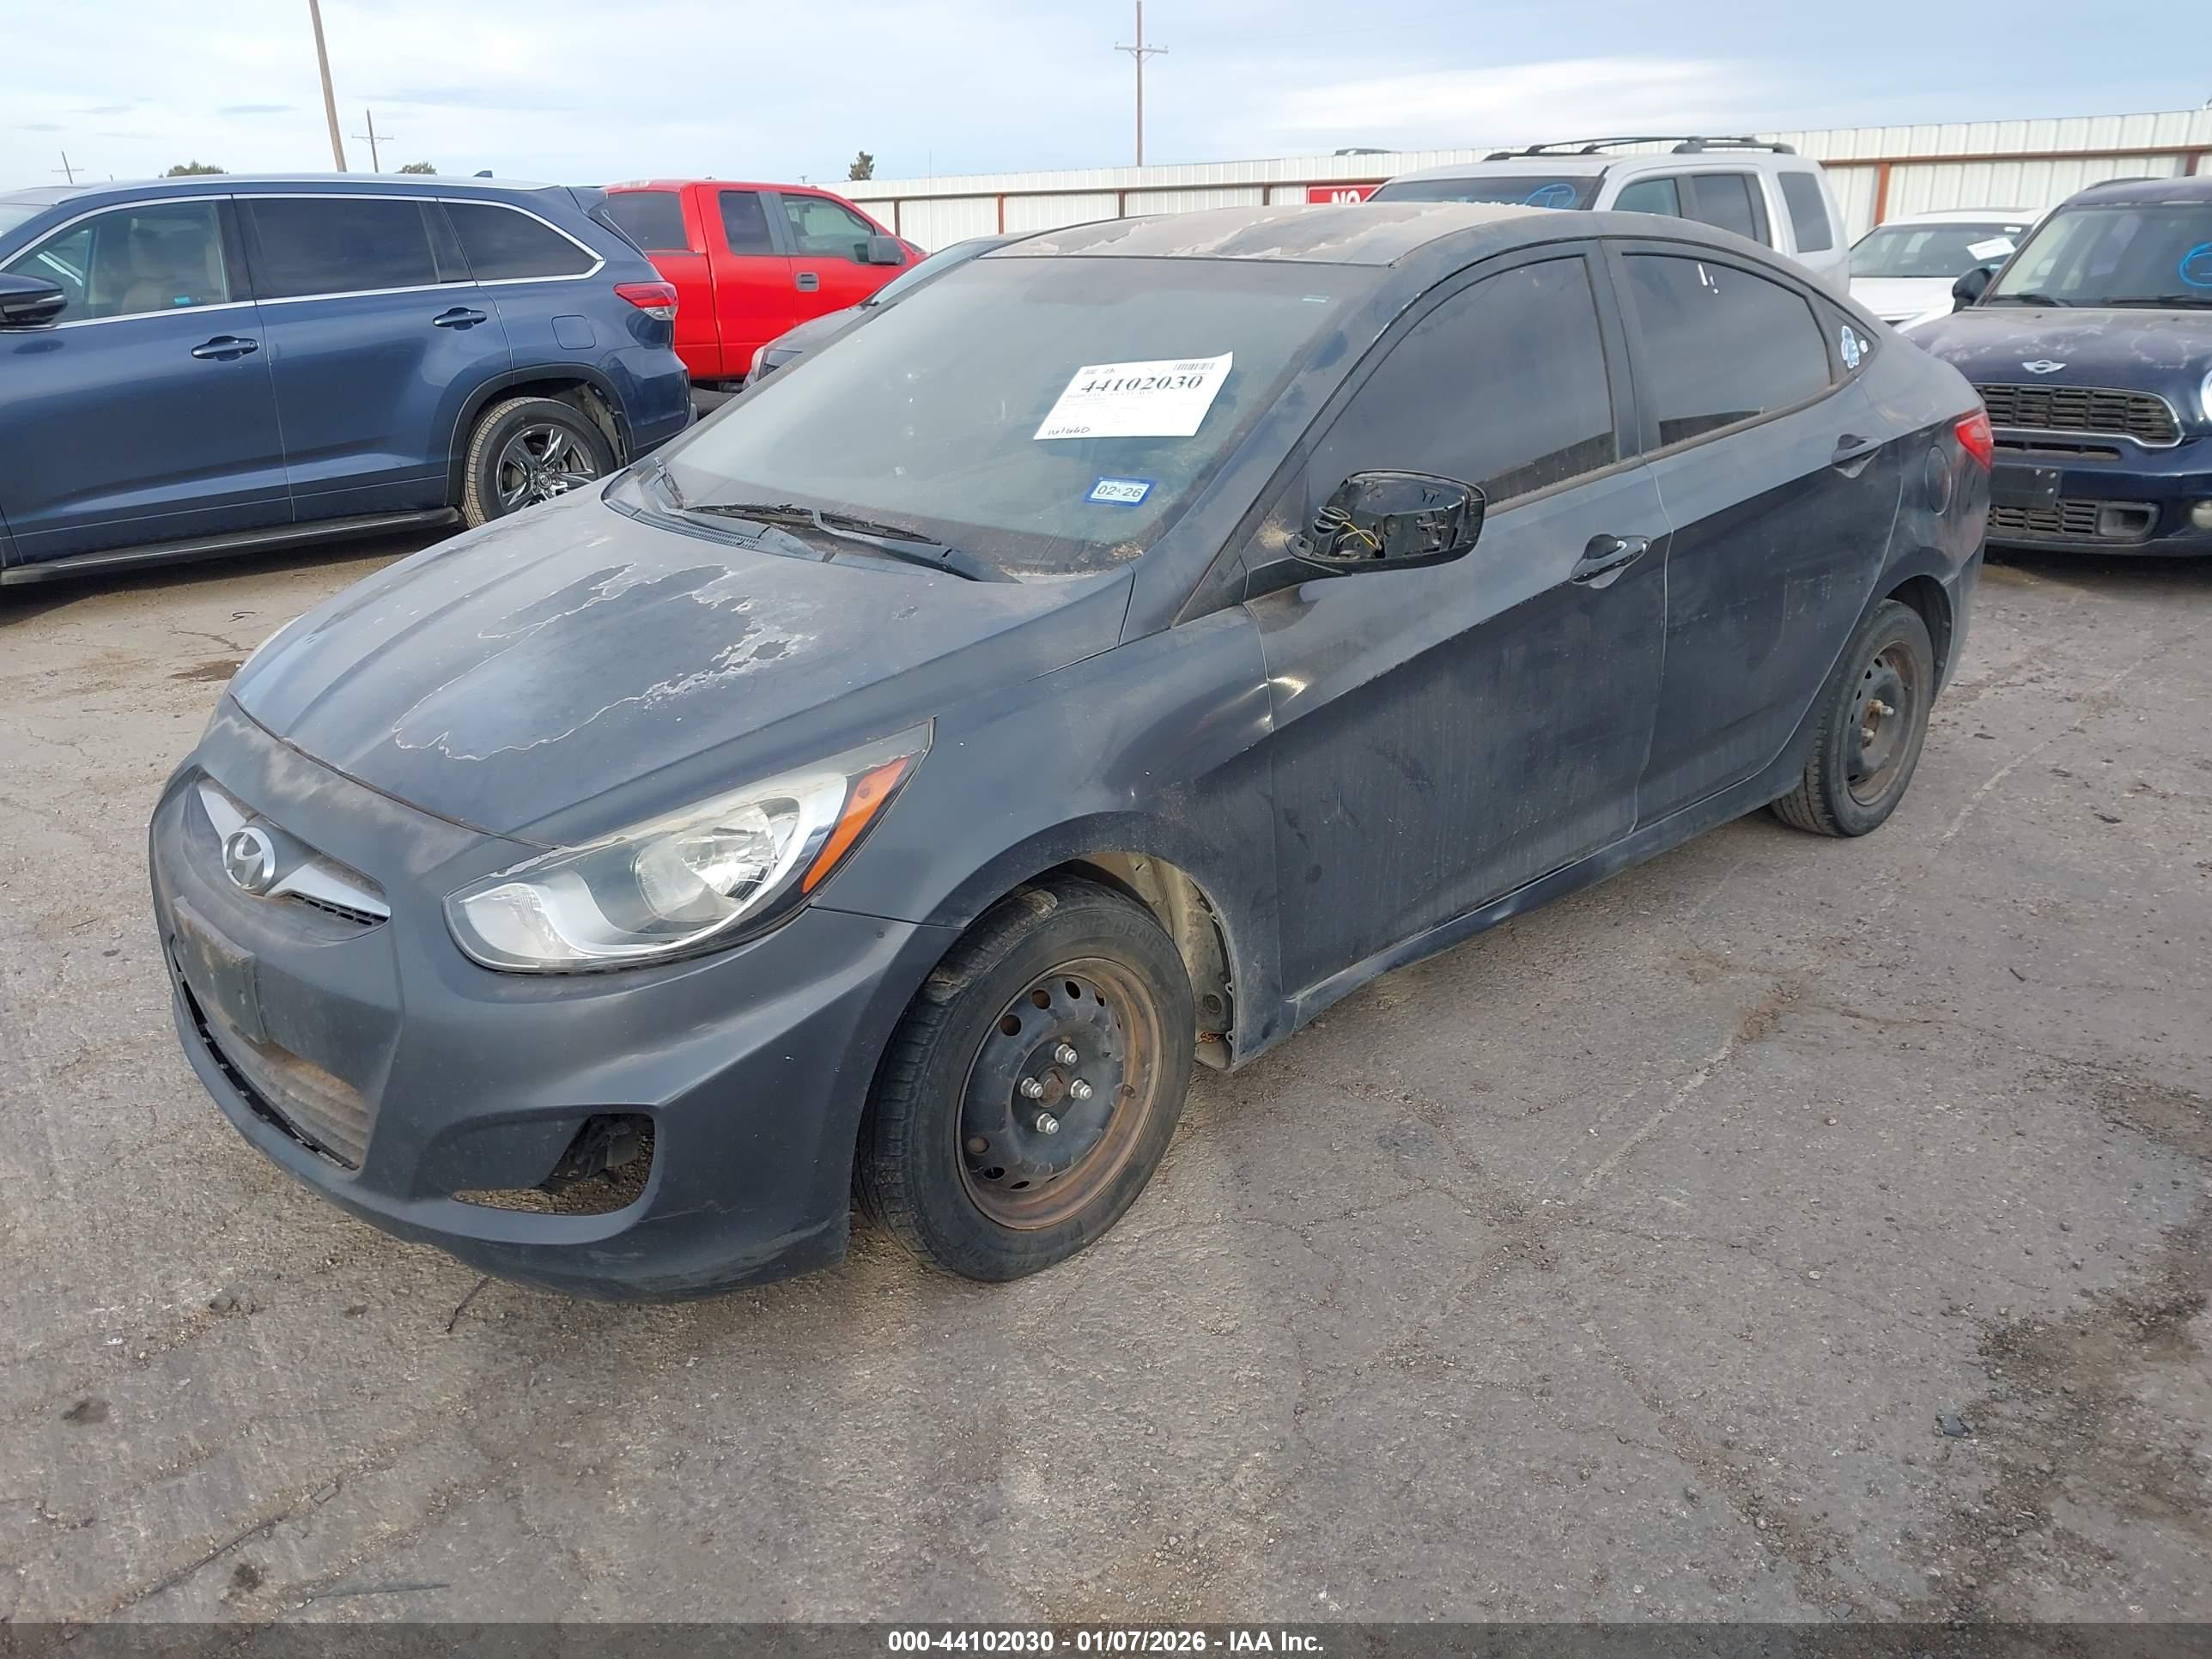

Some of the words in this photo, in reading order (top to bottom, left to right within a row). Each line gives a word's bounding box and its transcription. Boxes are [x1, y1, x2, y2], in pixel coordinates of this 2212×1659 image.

[1332, 189, 1361, 204] NO
[1081, 375, 1204, 392] 44102030
[1097, 485, 1117, 495] 02
[1122, 487, 1143, 497] 26
